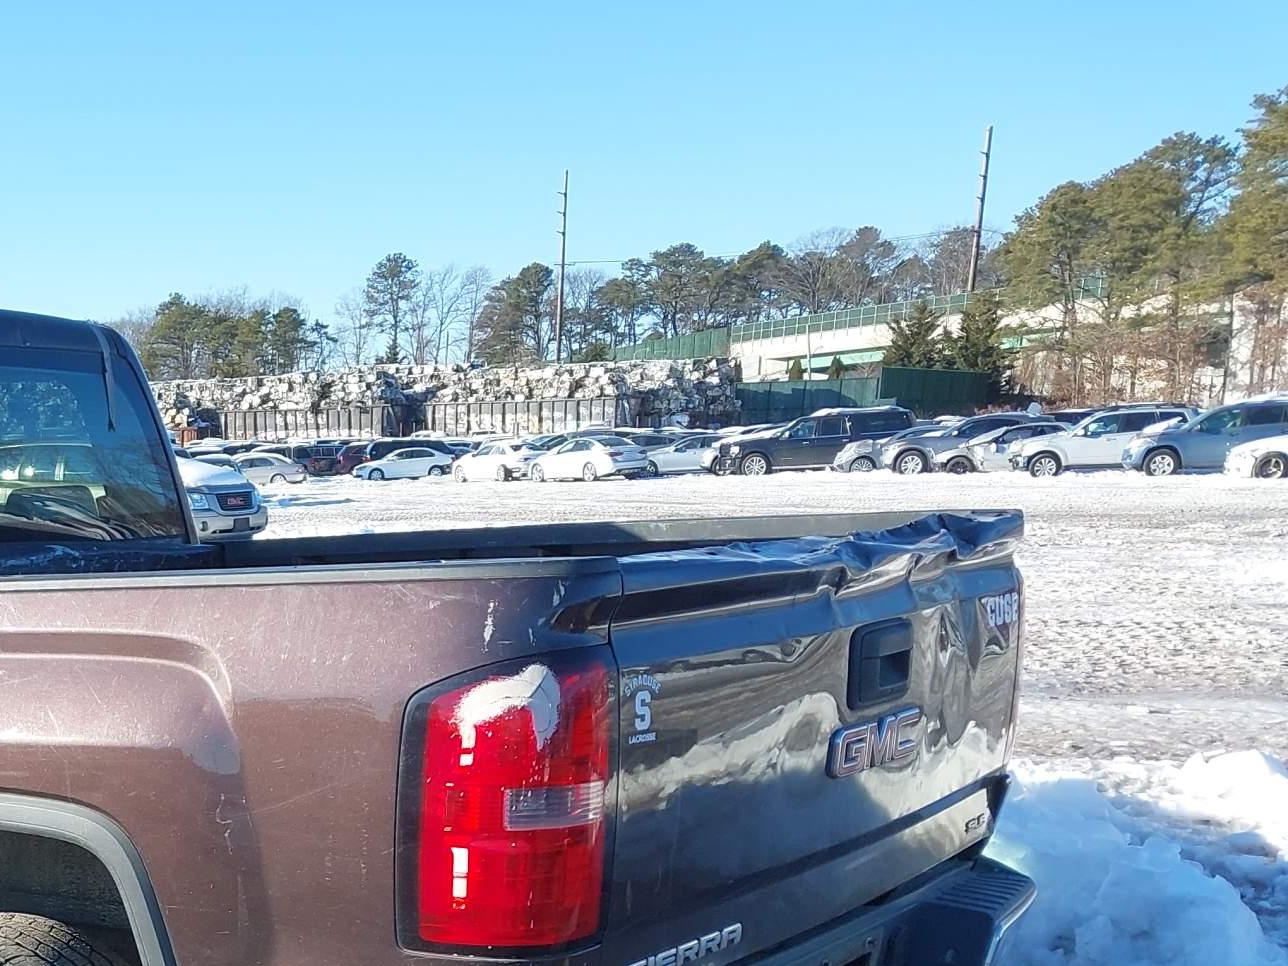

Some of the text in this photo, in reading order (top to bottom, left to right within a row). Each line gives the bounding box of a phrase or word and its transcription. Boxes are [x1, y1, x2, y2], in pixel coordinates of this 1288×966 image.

[624, 673, 662, 697] SYRACUSE
[634, 689, 652, 731] S
[628, 732, 657, 745] LACROSSE
[825, 707, 922, 778] GMC
